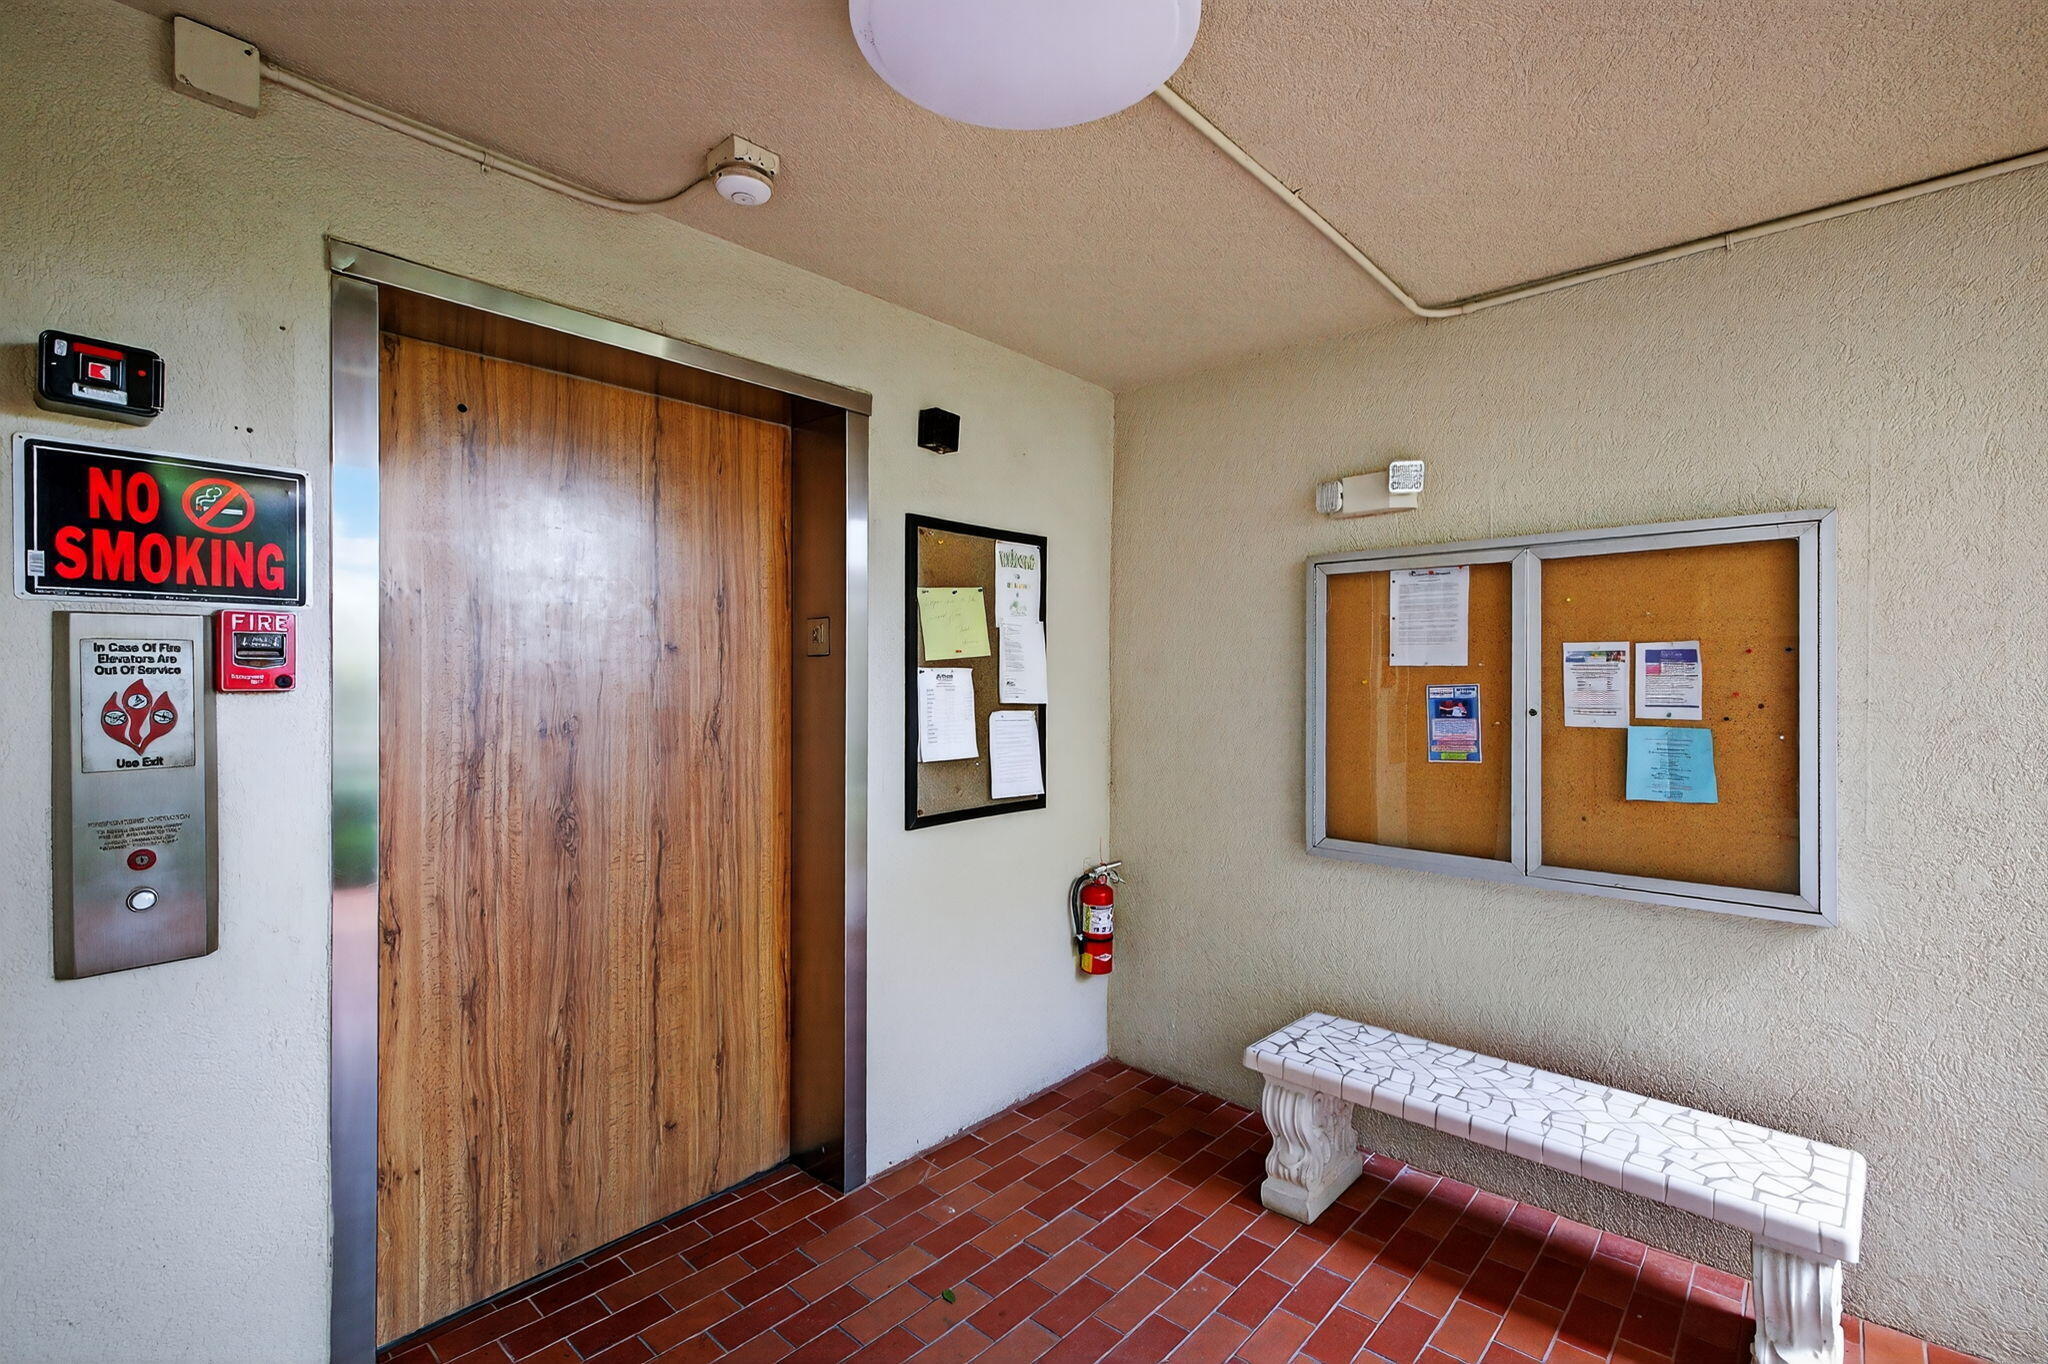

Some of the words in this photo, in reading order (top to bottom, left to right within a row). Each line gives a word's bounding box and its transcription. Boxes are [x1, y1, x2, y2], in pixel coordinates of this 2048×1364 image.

[88, 467, 160, 525] NO
[54, 525, 285, 591] SMOKING
[231, 613, 288, 632] FIRE
[93, 642, 105, 653] In
[108, 643, 139, 653] Case
[142, 643, 157, 653] Of
[159, 643, 182, 653] Fire
[97, 654, 155, 664] Elevators
[157, 654, 178, 664] Are
[94, 665, 118, 675] Out
[120, 665, 136, 675] Of
[137, 665, 182, 675] Service
[116, 758, 140, 769] Use
[142, 756, 164, 767] Exit
